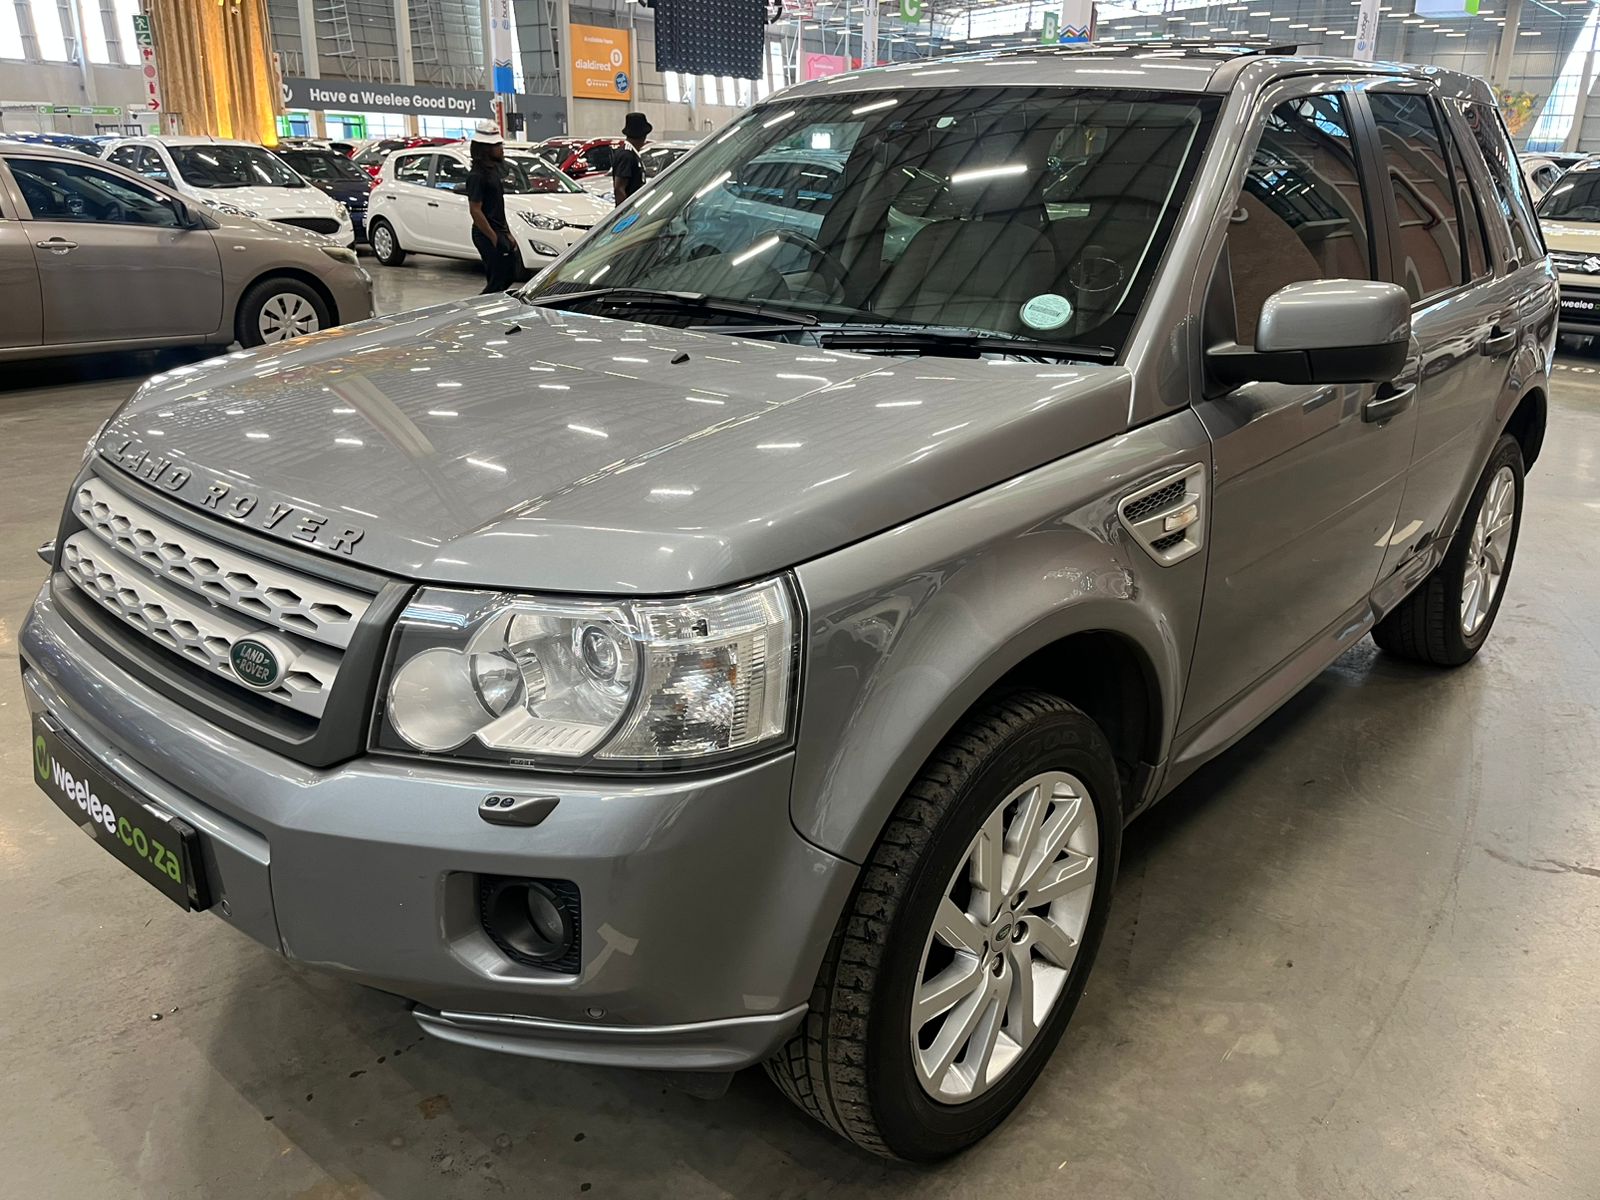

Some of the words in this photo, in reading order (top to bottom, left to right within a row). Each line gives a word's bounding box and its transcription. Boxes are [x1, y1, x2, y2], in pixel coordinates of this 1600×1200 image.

[905, 0, 917, 14] C
[1045, 17, 1055, 39] B
[575, 59, 611, 71] dialdirect
[309, 88, 347, 102] Have
[349, 92, 359, 103] a
[361, 92, 411, 107] Weelee
[412, 95, 446, 110] Good
[448, 97, 477, 114] Day!
[112, 440, 194, 491] LAND
[199, 479, 365, 555] ROVER
[240, 645, 265, 664] LAND
[239, 658, 270, 681] ROVER
[51, 756, 182, 884] weelee.co.za
